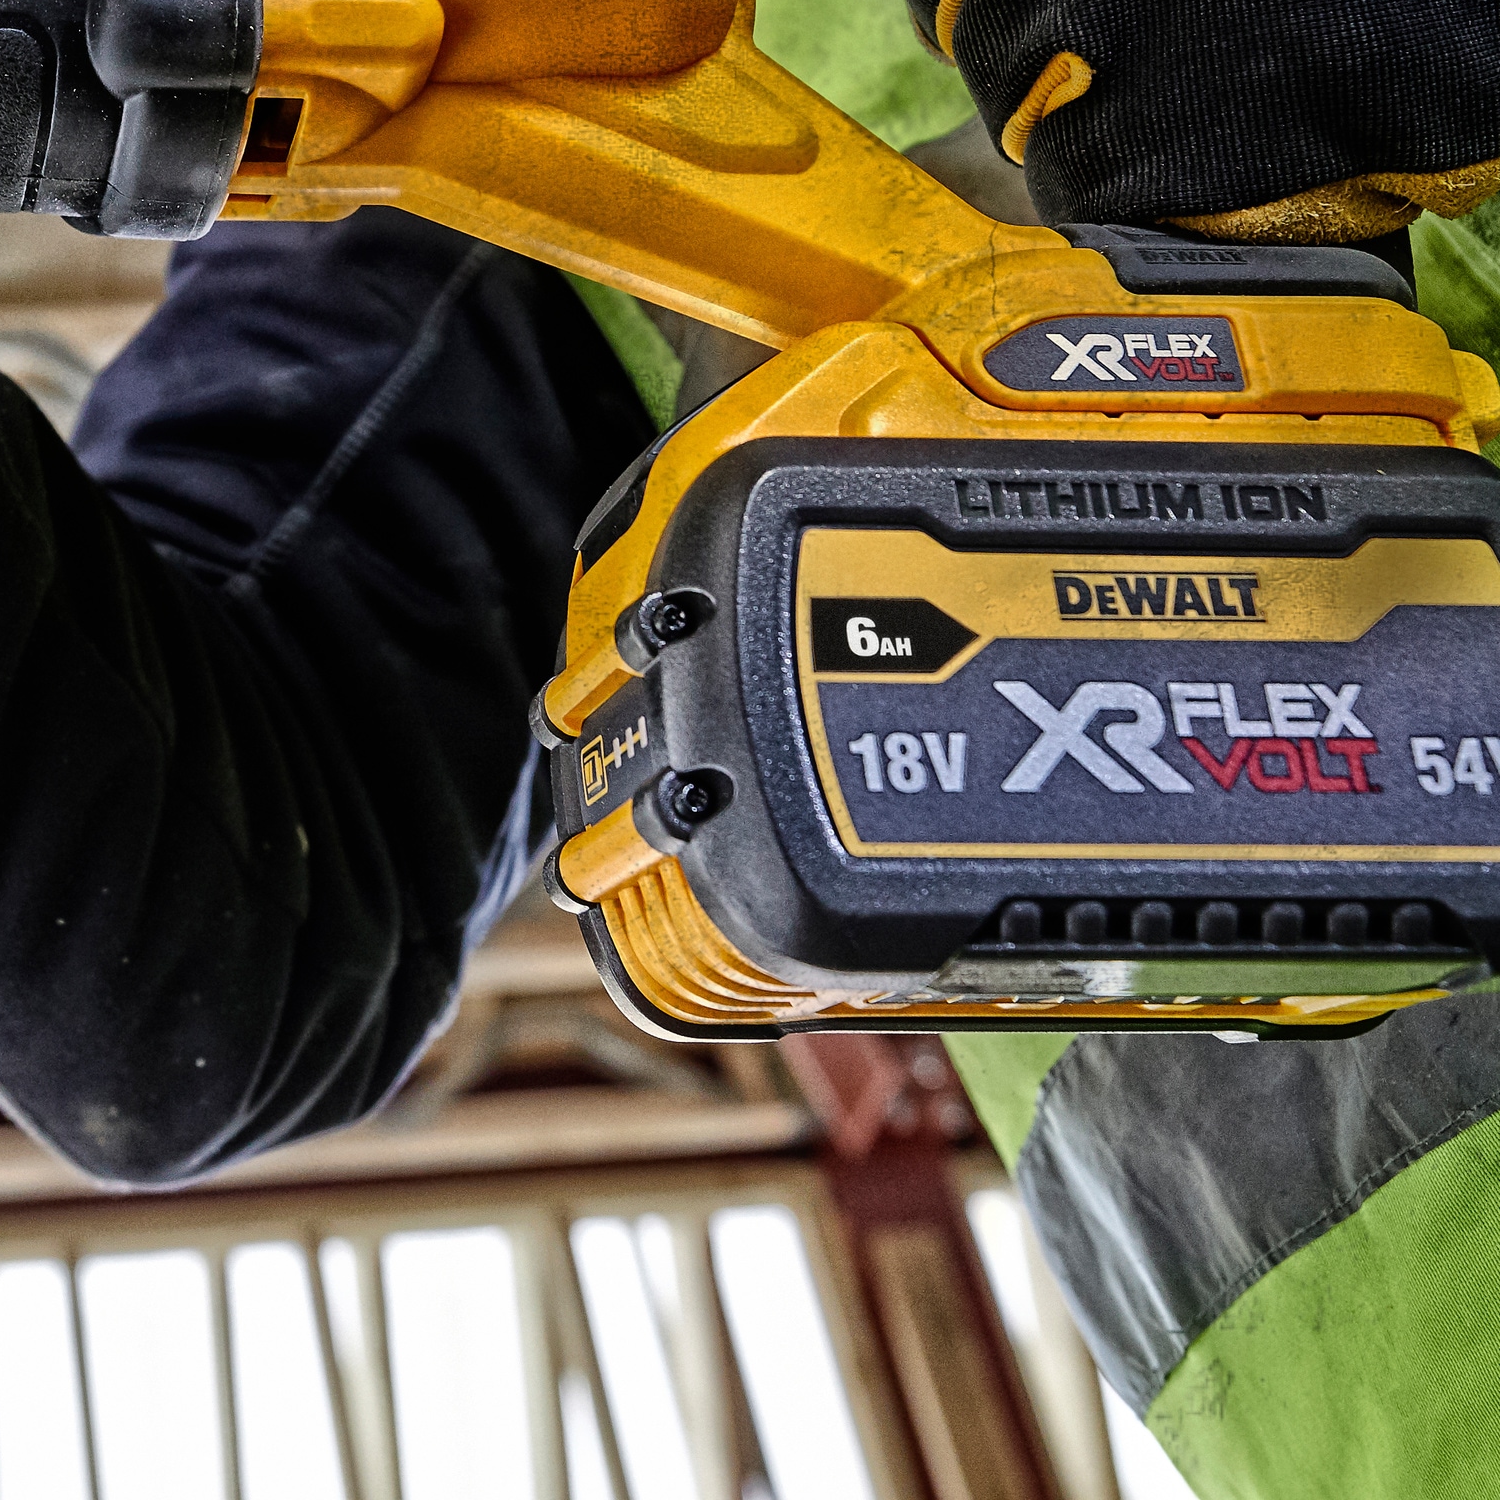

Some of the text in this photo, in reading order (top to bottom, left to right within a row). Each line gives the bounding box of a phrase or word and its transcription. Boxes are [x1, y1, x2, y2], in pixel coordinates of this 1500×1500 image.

[1045, 333, 1218, 381] XR FLEX
[1130, 357, 1220, 381] VOLT
[956, 479, 1329, 522] LITHIUM ION
[849, 731, 968, 794] 18V
[993, 681, 1374, 794] XR FLEX
[1179, 737, 1380, 793] VOLT
